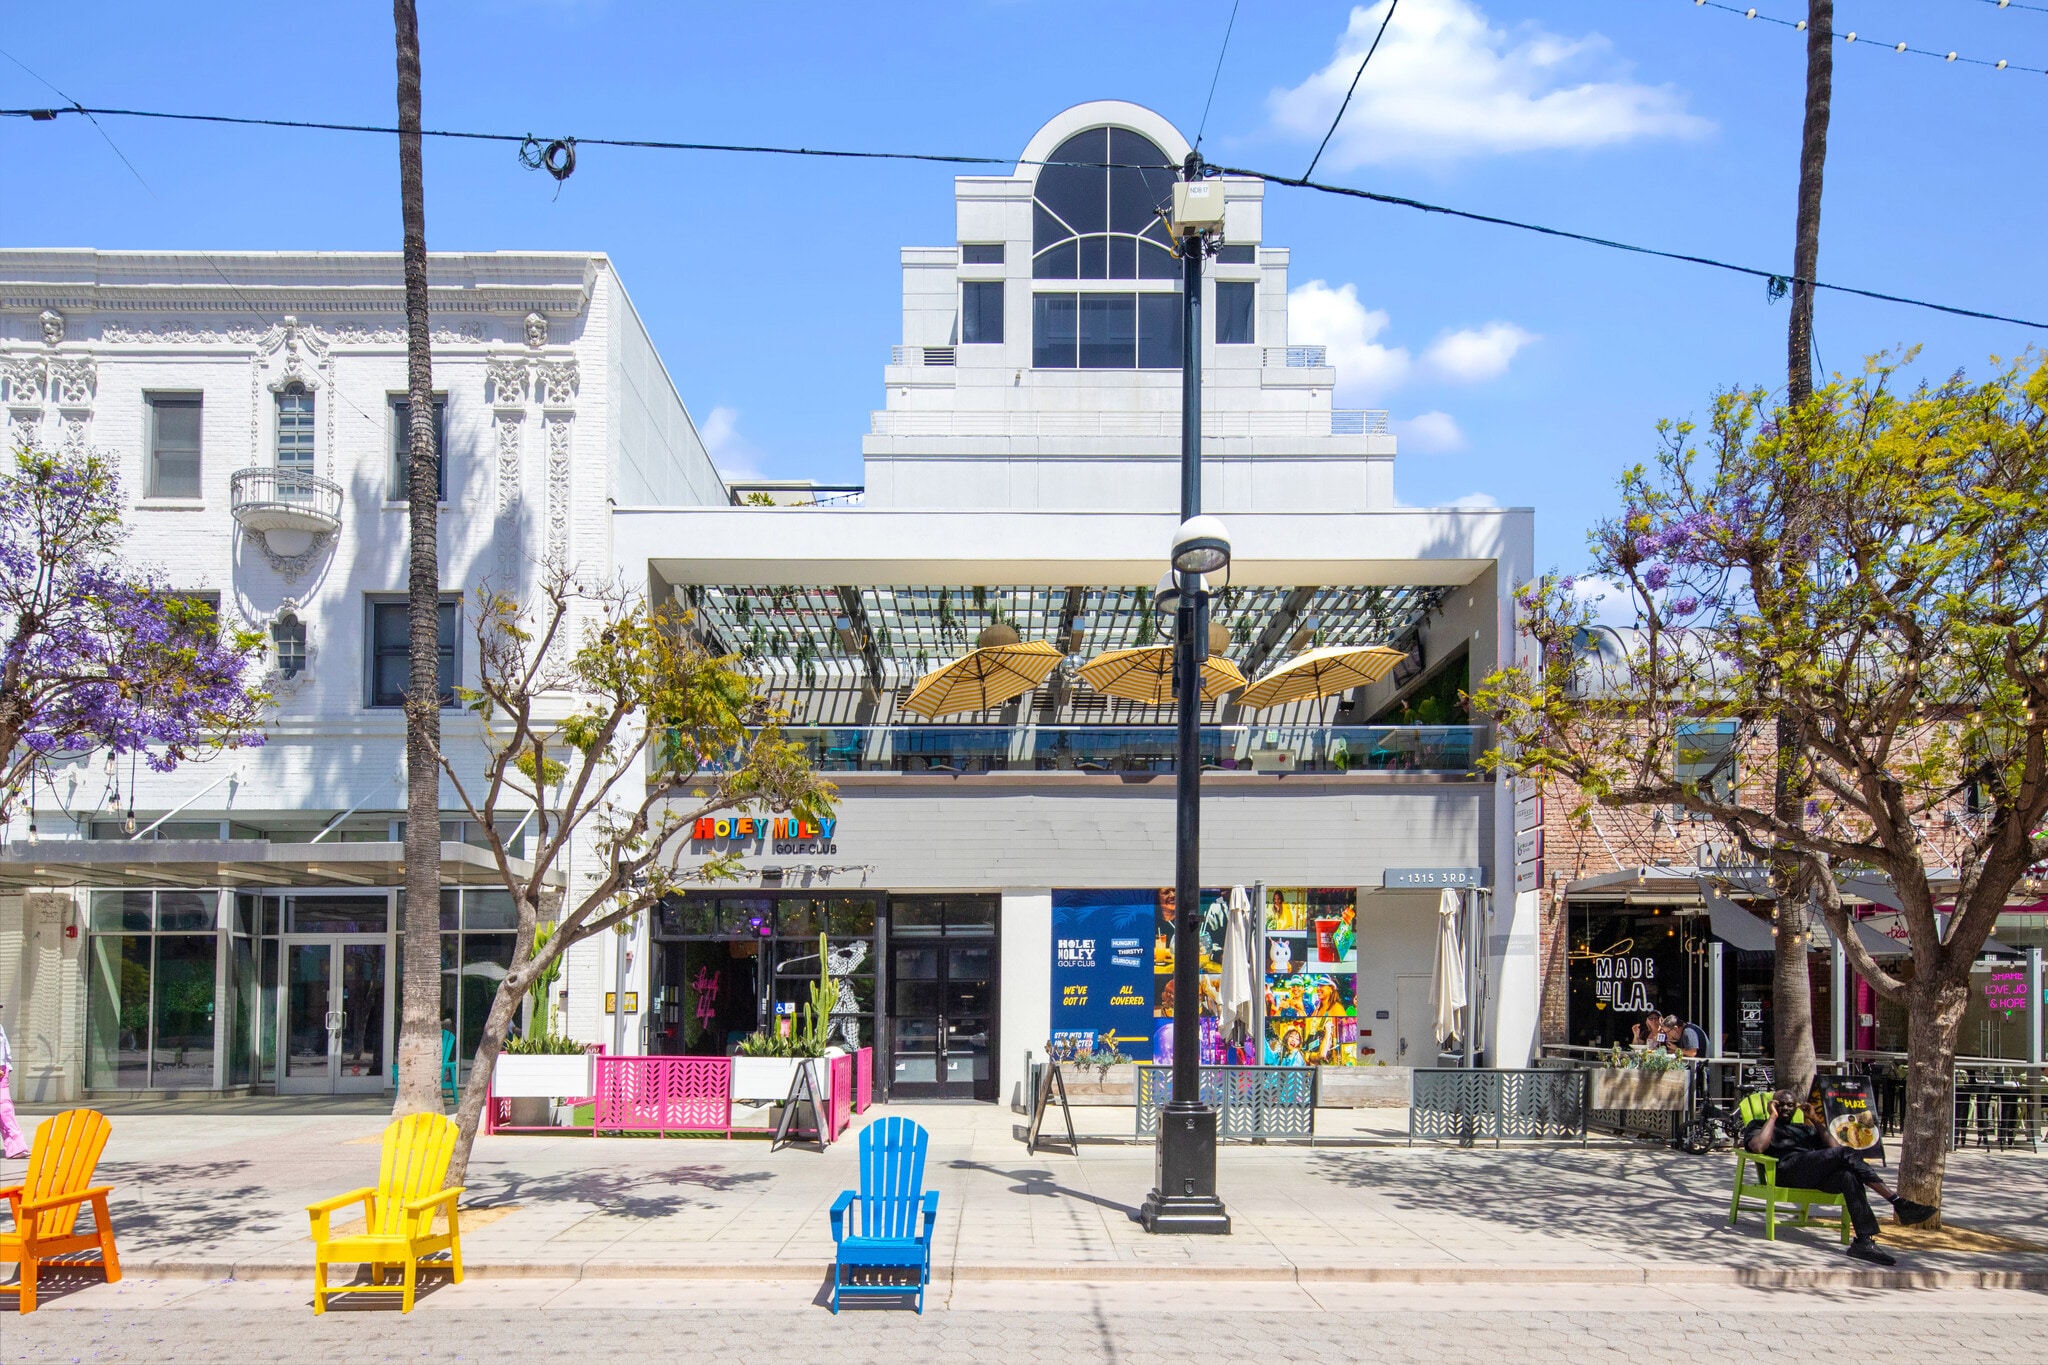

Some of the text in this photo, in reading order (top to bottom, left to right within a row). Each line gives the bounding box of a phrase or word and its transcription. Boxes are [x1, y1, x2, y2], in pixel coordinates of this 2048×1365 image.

[693, 817, 768, 840] HOLEY
[776, 844, 837, 855] GOLF CLUB
[1408, 873, 1466, 883] 1315 3RD
[1057, 939, 1095, 948] HOLEY
[1057, 960, 1096, 968] GOLF CLUB
[1596, 957, 1654, 979] MADE
[1063, 985, 1088, 995] WE'VE
[1119, 985, 1133, 995] ALL
[2013, 983, 2028, 994] JO
[1062, 996, 1088, 1006] GOT IT
[1109, 996, 1145, 1006] COVERED.
[1596, 980, 1655, 1012] IN L.A.
[1990, 998, 2026, 1009] & HOPE
[1053, 1031, 1068, 1039] STEP
[1083, 1031, 1095, 1039] THE
